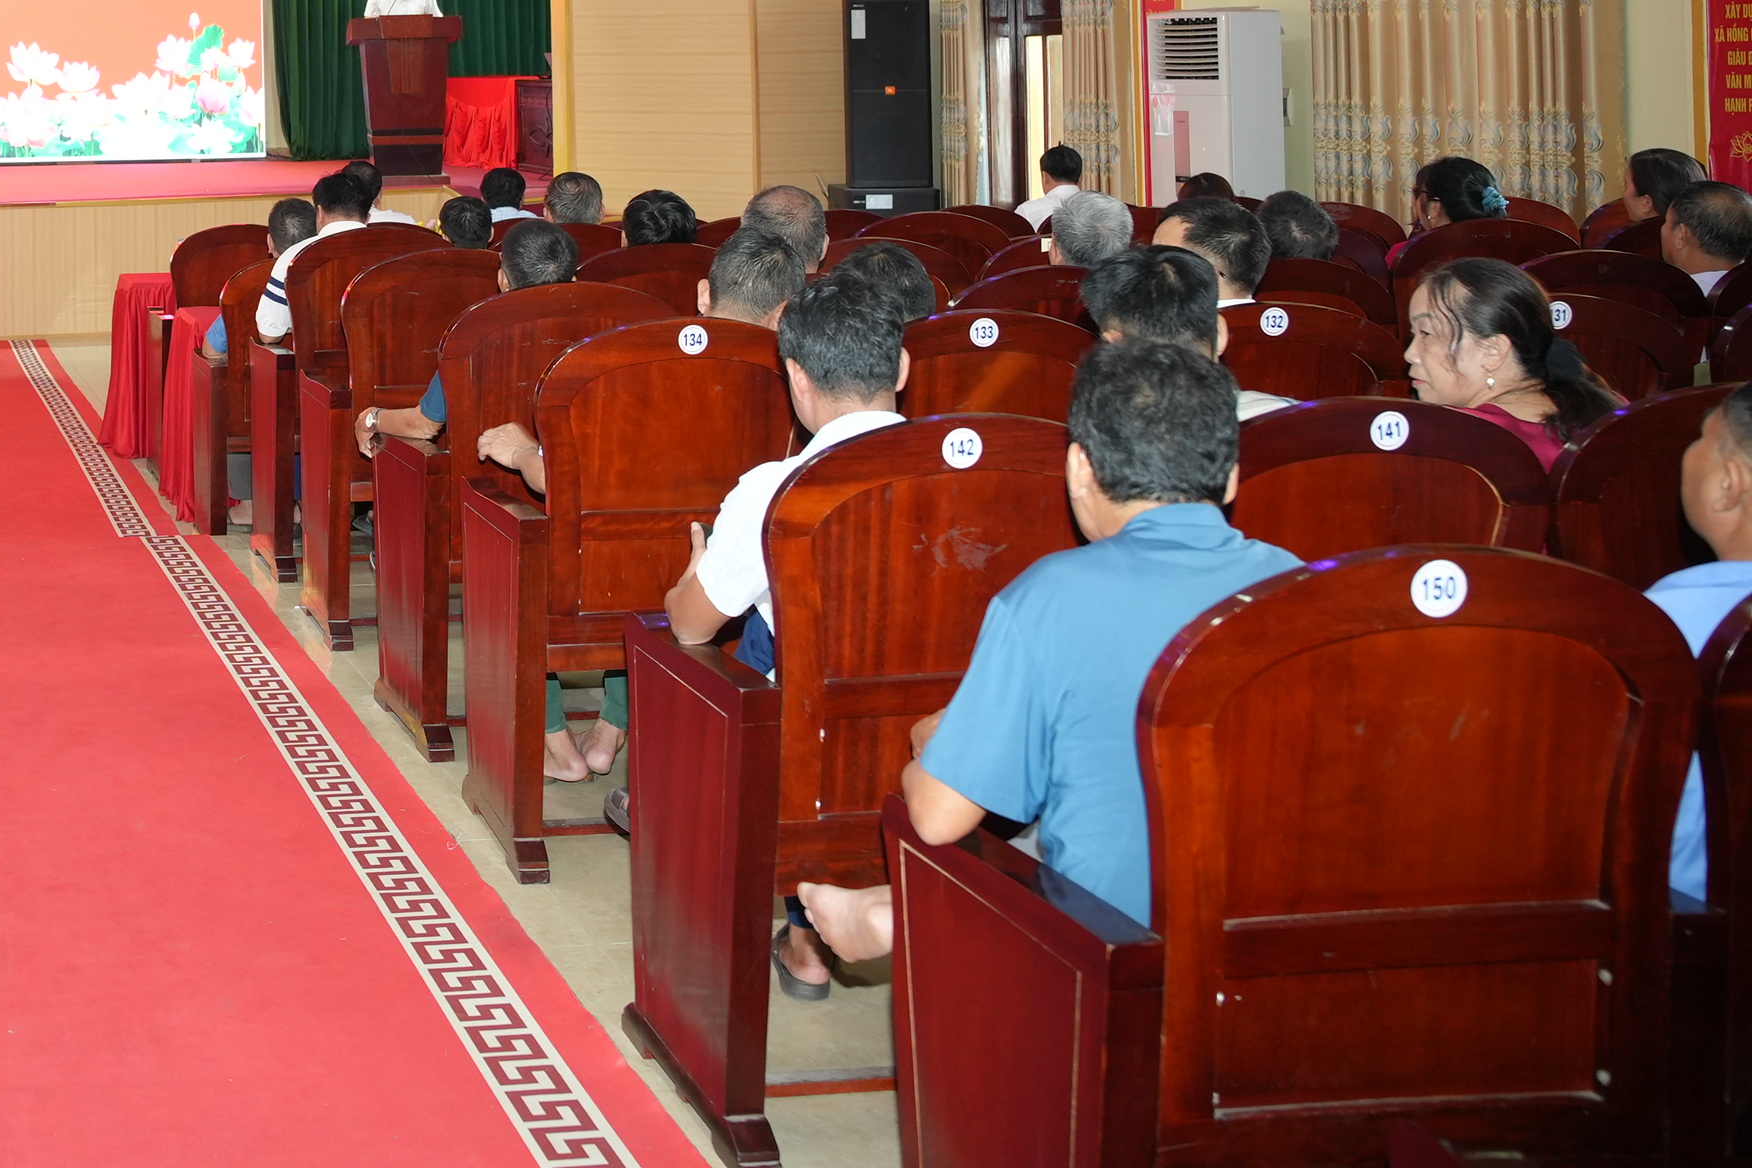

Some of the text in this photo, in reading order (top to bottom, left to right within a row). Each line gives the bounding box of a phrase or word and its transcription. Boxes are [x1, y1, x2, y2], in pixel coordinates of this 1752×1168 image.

[1728, 47, 1747, 66] GIÀU
[1725, 72, 1742, 89] VĂN
[1725, 98, 1747, 115] HẠNH
[1265, 315, 1284, 329] 132
[683, 333, 703, 347] 134
[975, 325, 994, 340] 133
[1377, 421, 1401, 440] 141
[950, 438, 975, 457] 142
[1422, 576, 1456, 601] 150
